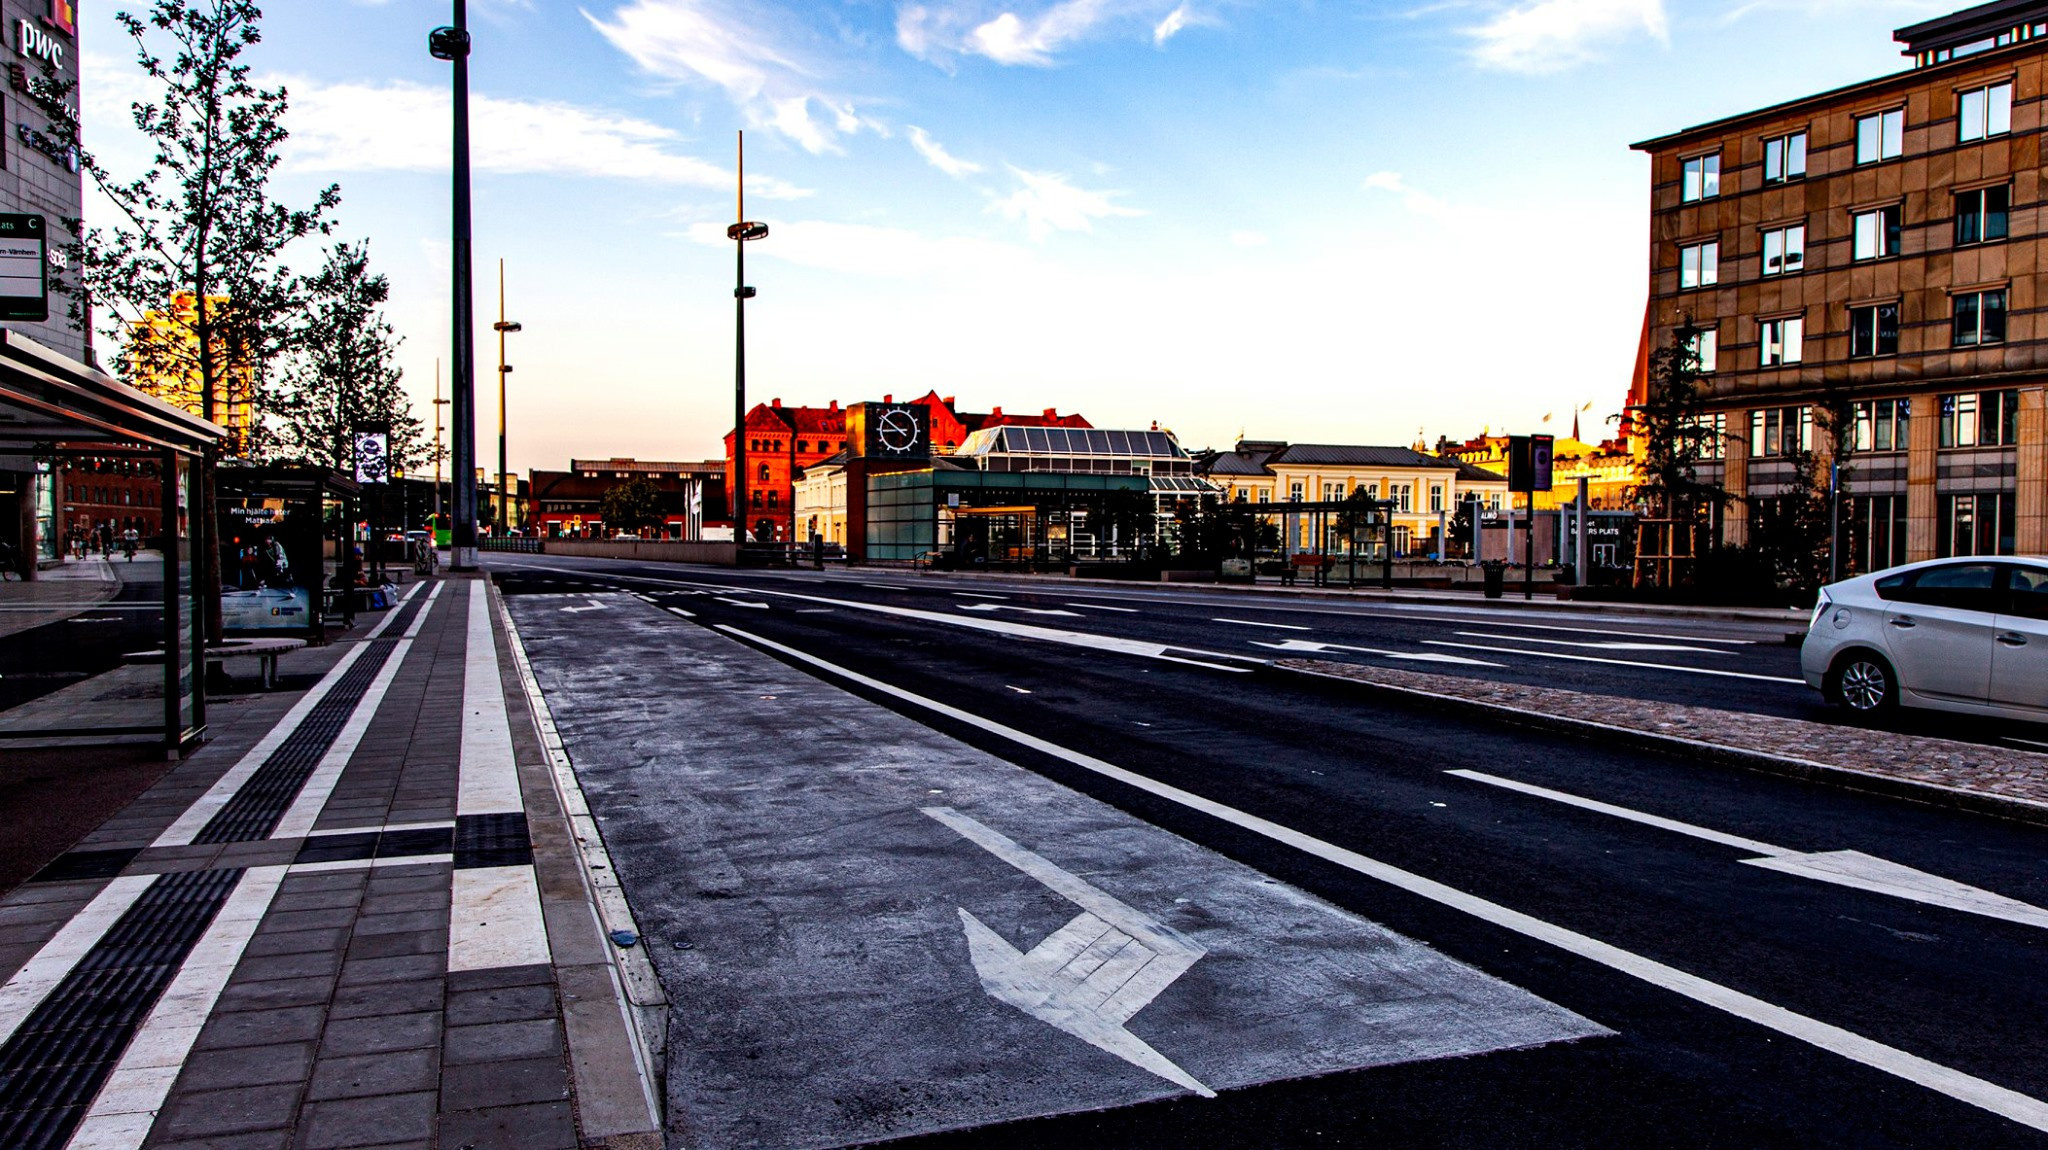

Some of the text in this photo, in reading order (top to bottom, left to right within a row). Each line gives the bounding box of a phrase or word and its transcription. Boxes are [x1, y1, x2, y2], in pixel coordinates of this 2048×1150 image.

[20, 19, 62, 69] pwc
[28, 218, 37, 229] C
[230, 507, 245, 515] Min
[246, 507, 268, 516] hjälte
